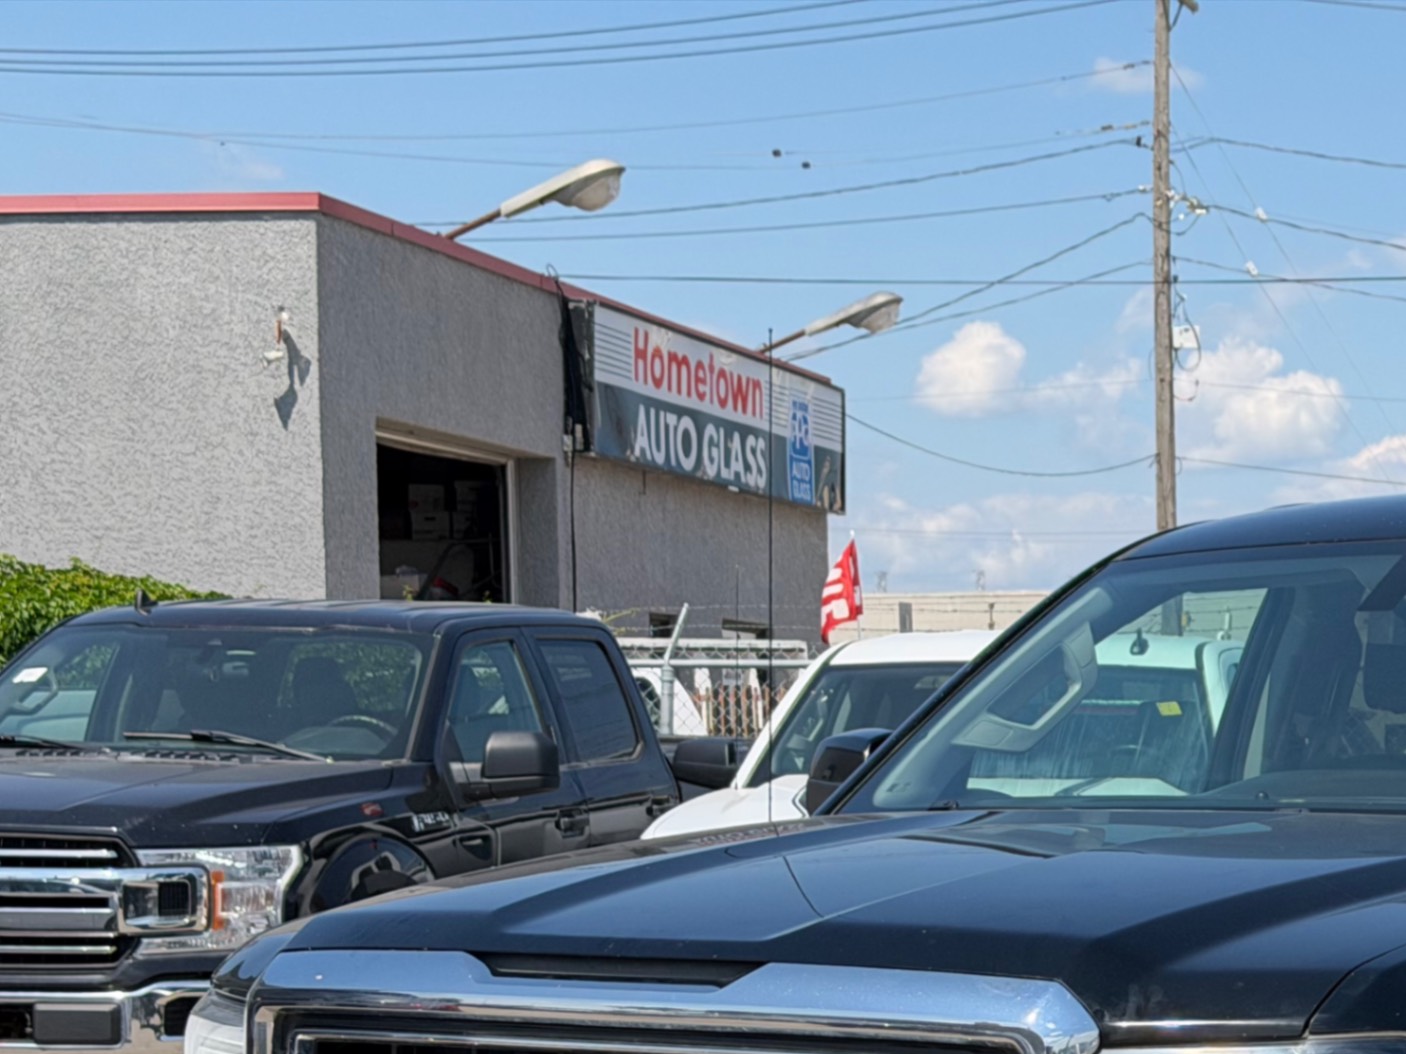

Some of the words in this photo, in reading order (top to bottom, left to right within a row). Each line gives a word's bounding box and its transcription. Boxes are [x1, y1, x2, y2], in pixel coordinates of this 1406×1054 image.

[633, 326, 764, 421] Hometown
[633, 403, 698, 473] AUTO
[702, 422, 767, 489] GLASS
